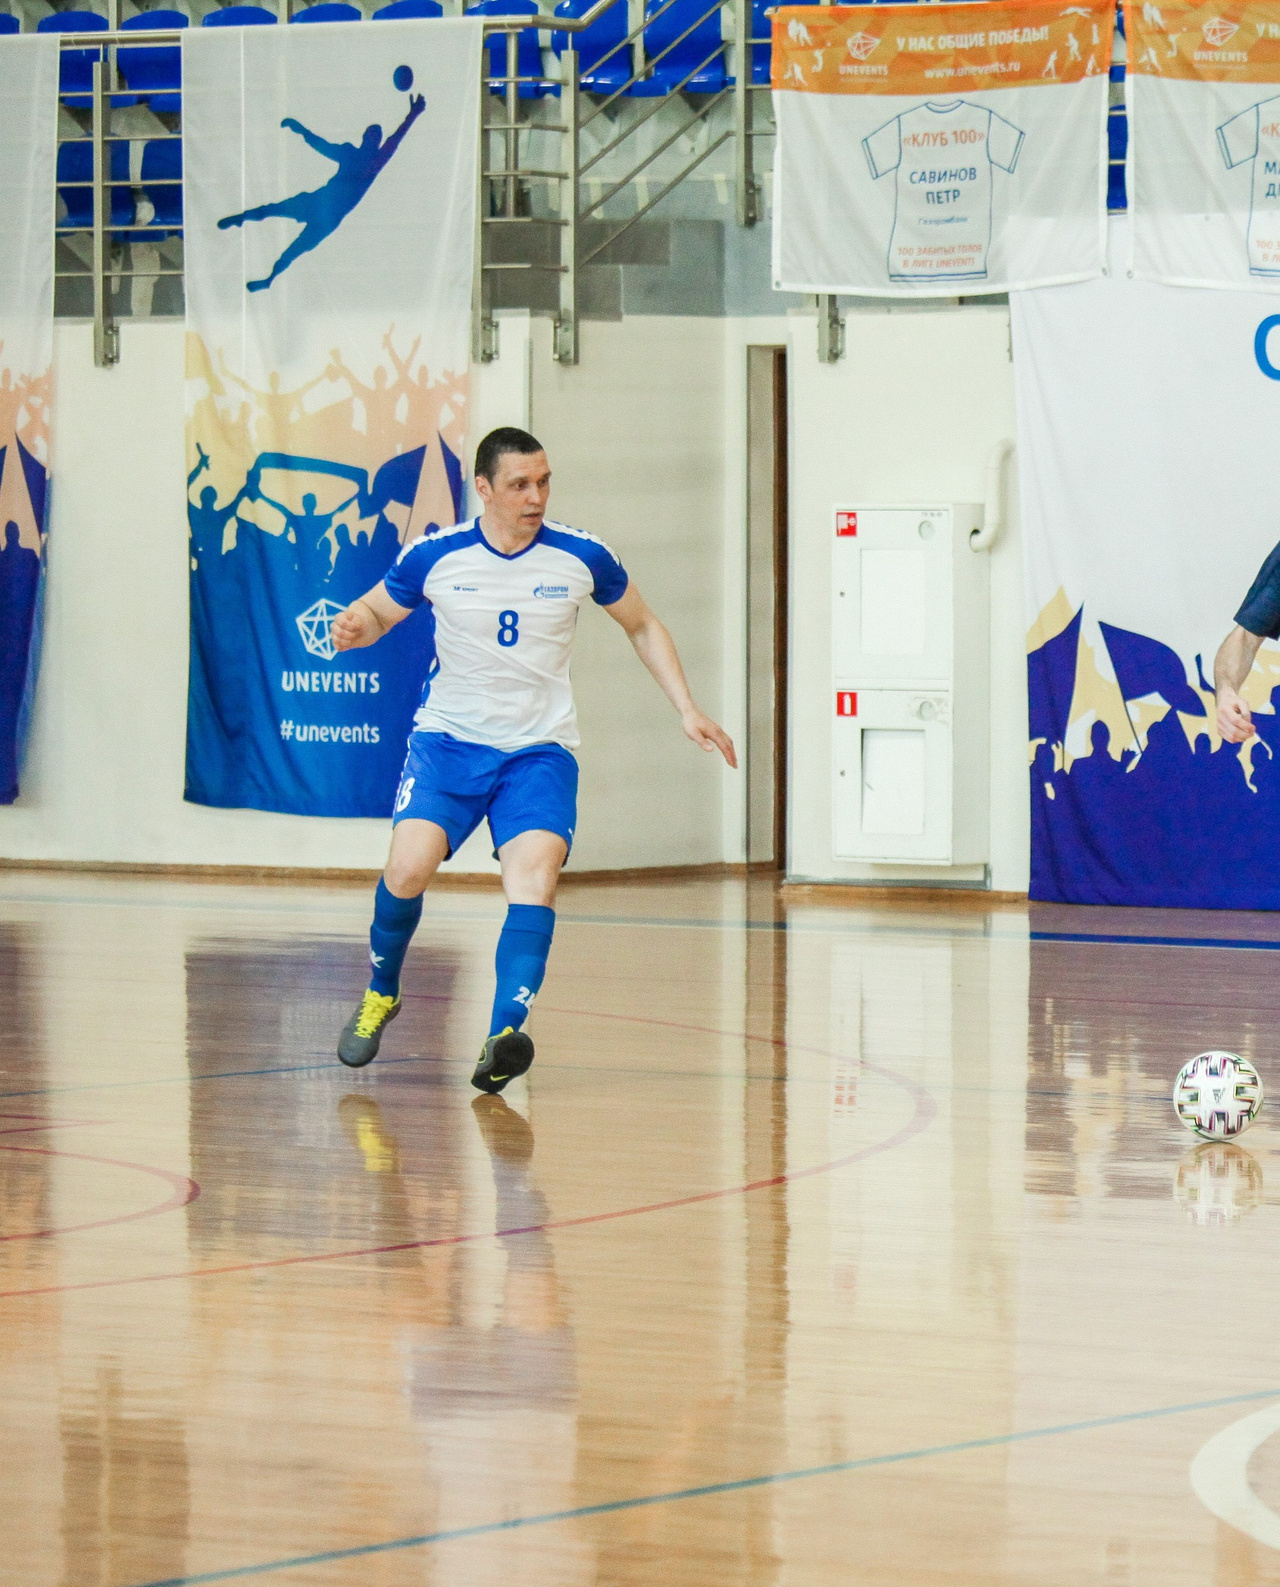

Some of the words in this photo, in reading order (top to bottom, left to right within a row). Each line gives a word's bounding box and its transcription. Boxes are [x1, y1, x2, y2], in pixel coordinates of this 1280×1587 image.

[897, 38, 906, 51] У
[909, 36, 934, 51] НАС
[938, 32, 985, 50] ОБЩИЕ
[989, 25, 1050, 47] ПОБЕДЫ!
[1255, 23, 1266, 37] У
[1193, 50, 1248, 63] UNEVENTS
[838, 64, 888, 76] UNEVENTS
[924, 61, 1020, 79] www.unevents.ru
[903, 132, 948, 148] «КЛУБ
[953, 129, 985, 144] 100»
[910, 167, 977, 184] САВИНОВ
[926, 189, 960, 205] ПЕТР
[497, 609, 520, 648] 8
[281, 671, 380, 694] UNEVENTS
[280, 719, 380, 744] #unevents
[396, 777, 416, 812] 8
